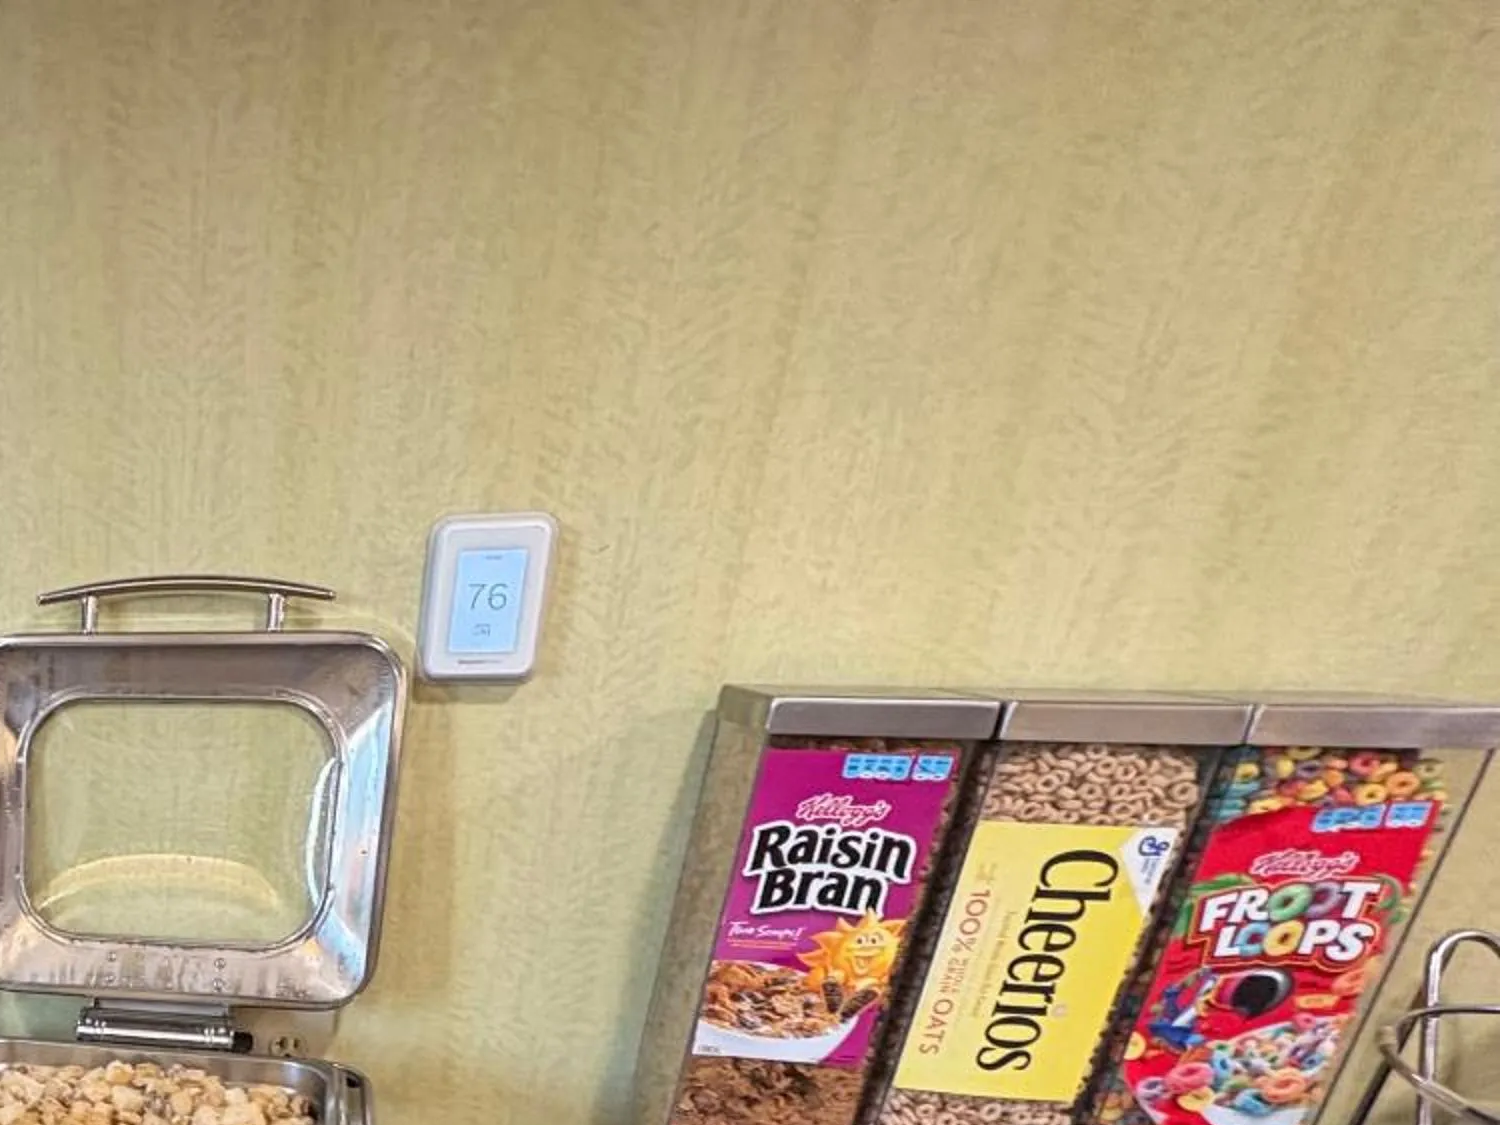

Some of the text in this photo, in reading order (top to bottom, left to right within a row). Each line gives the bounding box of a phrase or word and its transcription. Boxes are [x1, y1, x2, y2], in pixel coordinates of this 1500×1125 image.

[467, 582, 508, 612] 76
[796, 793, 892, 827] Kellogg's
[748, 824, 914, 880] Raisin
[755, 868, 884, 914] Bran
[1200, 880, 1382, 934] FROOT
[950, 889, 991, 953] 100%
[1214, 918, 1377, 963] LOOPS
[975, 849, 1119, 1071] Cheerios
[918, 998, 955, 1055] OATS
